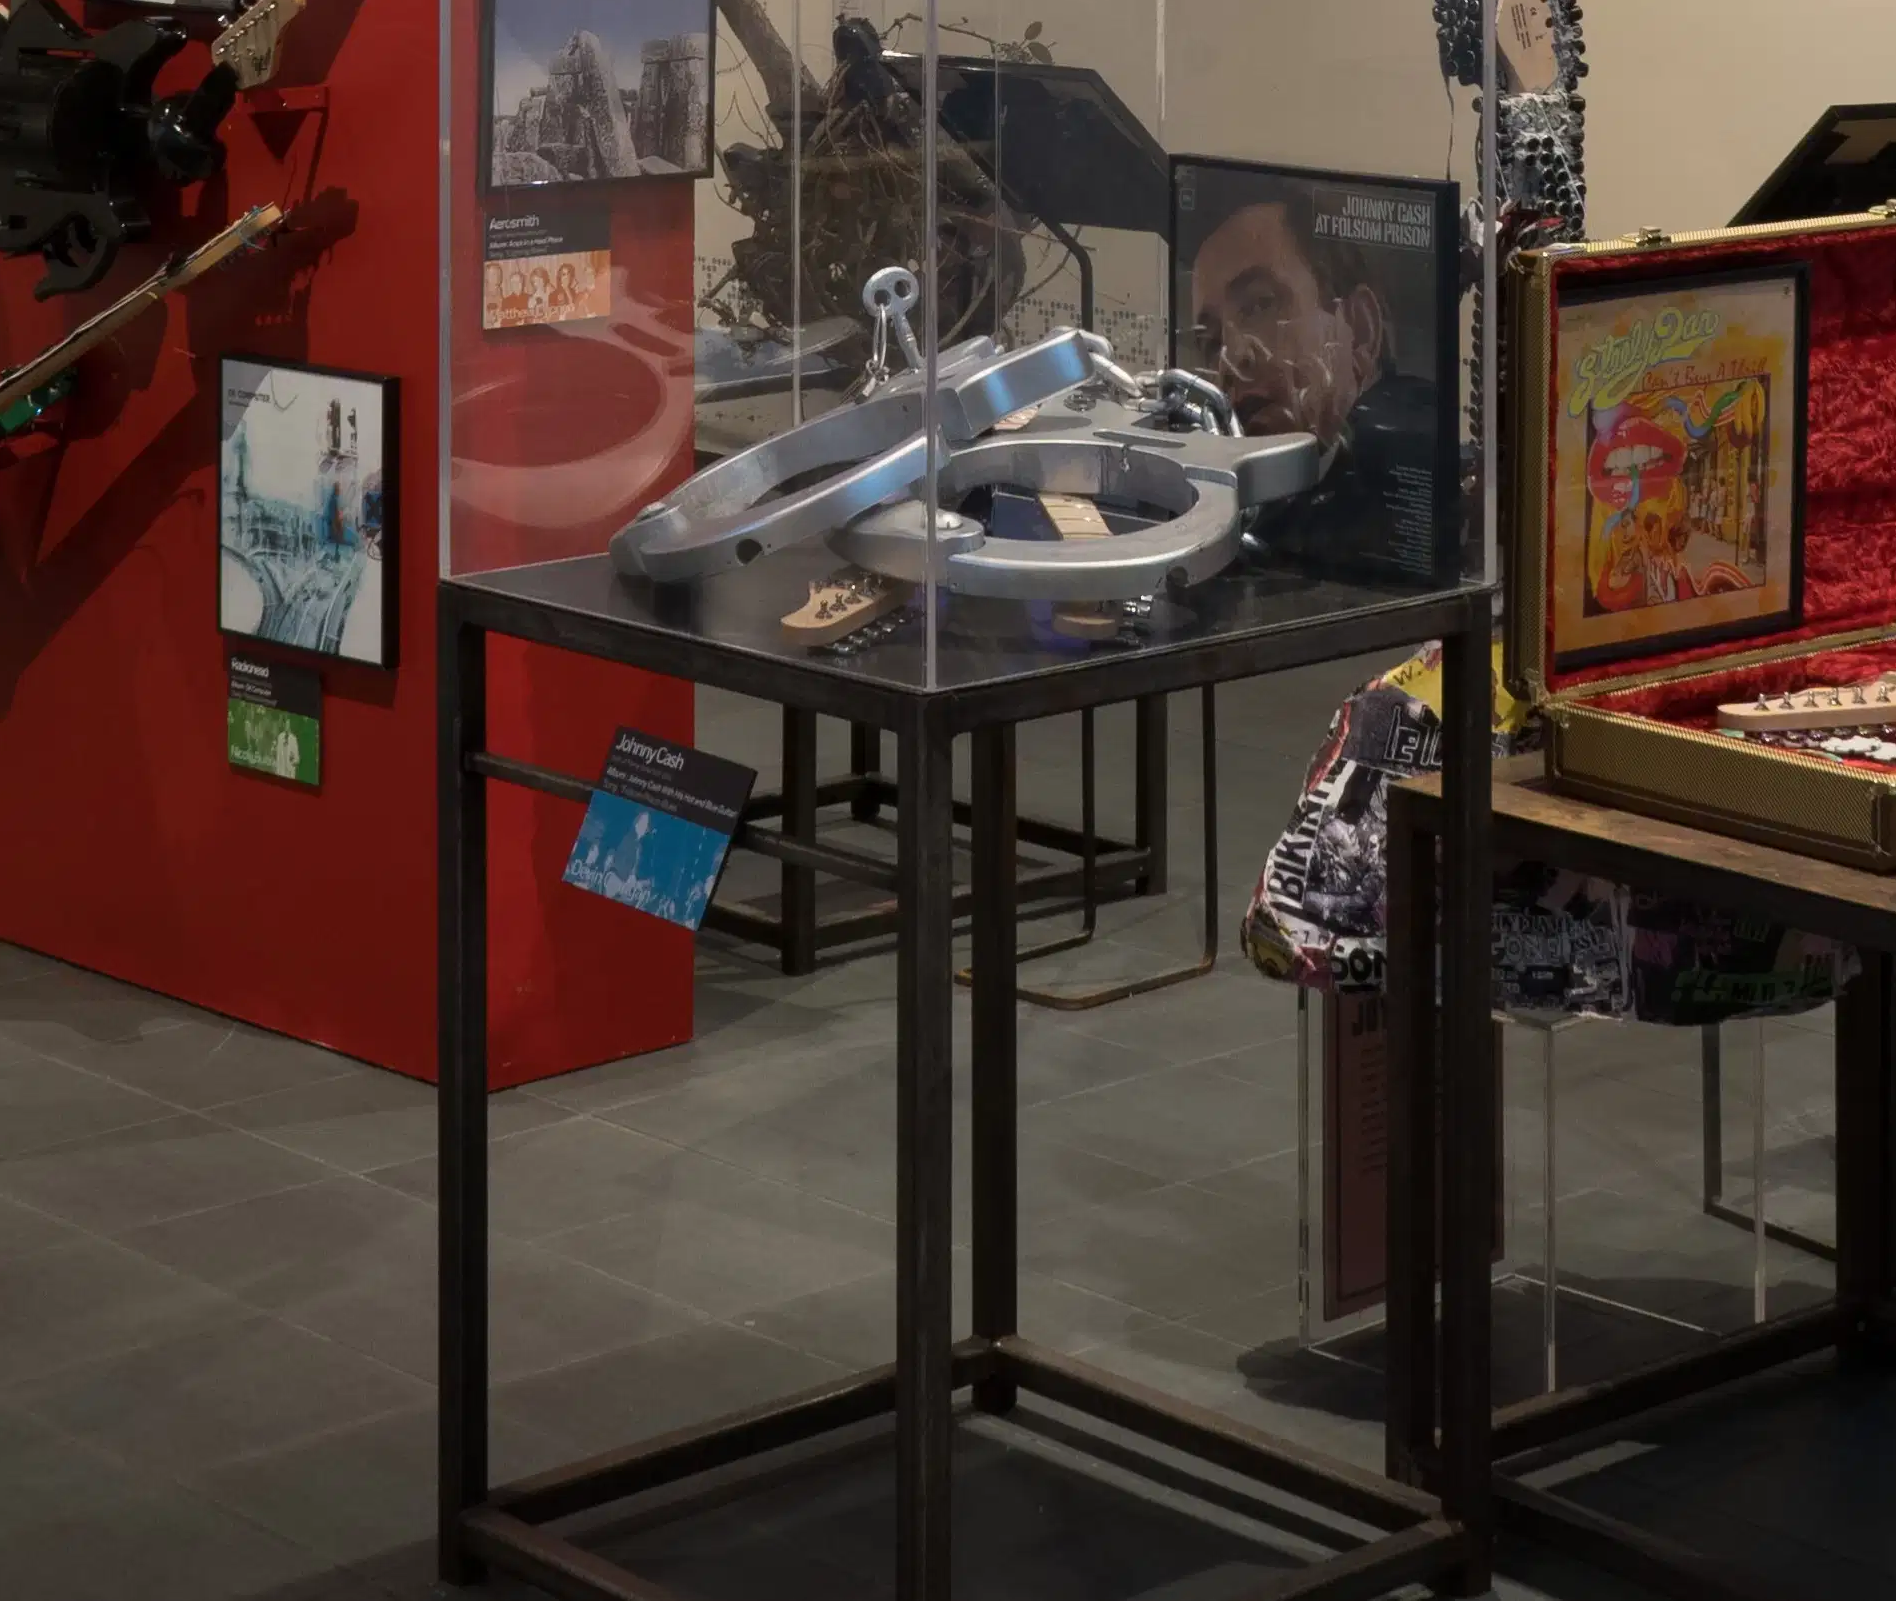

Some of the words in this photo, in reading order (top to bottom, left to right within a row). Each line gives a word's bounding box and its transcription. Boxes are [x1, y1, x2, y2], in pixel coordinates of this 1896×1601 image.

[489, 214, 540, 231] Aerosmith
[1342, 194, 1397, 221] JOHNNY
[1397, 202, 1432, 227] CASH
[1314, 212, 1330, 235] AT
[1332, 215, 1383, 242] FOLSOM
[1384, 221, 1431, 248] PRISON
[615, 733, 657, 764] Johnny
[656, 746, 685, 772] Cash
